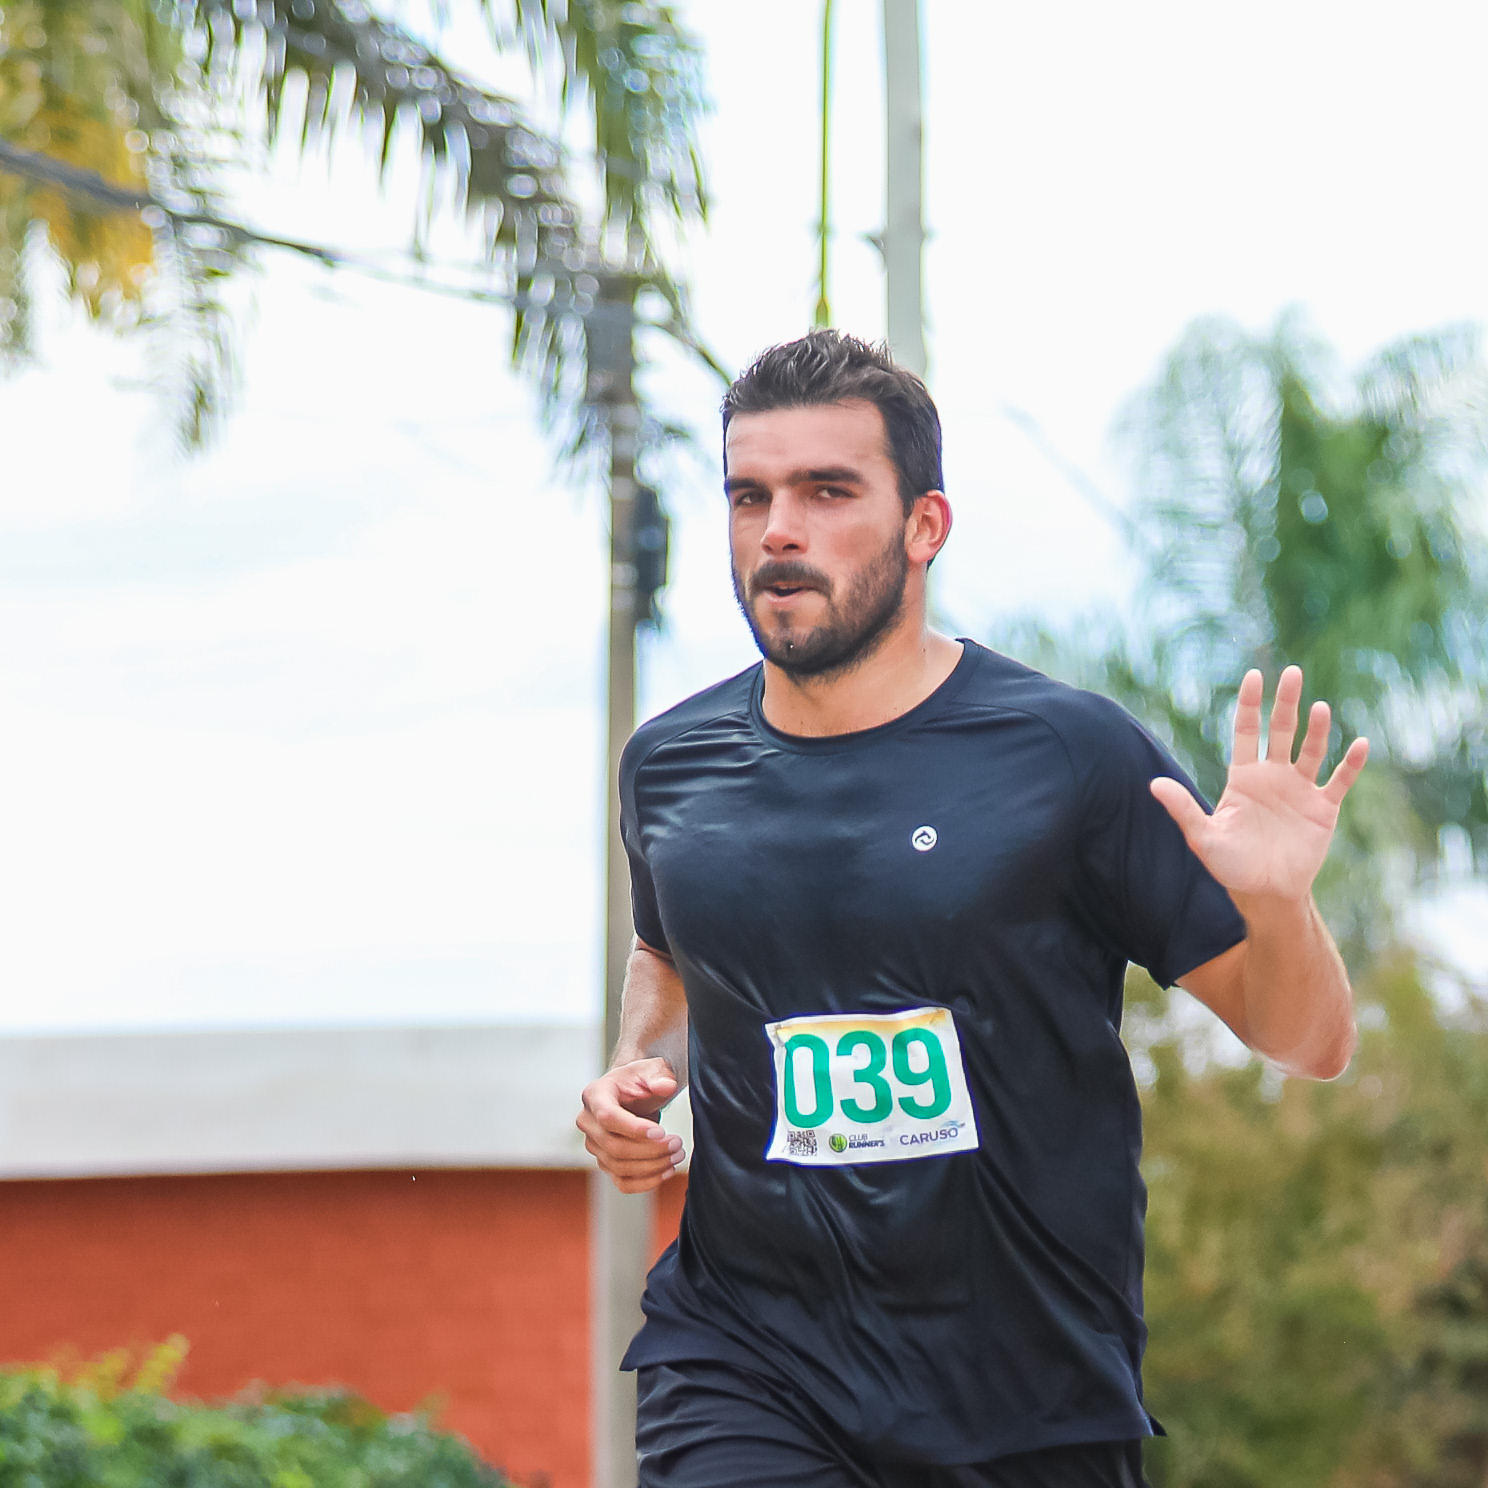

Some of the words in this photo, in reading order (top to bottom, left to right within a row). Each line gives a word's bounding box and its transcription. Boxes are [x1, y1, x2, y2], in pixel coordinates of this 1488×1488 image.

[784, 1028, 951, 1128] 039
[848, 1133, 868, 1141] CLUB
[899, 1127, 959, 1145] CARUSO
